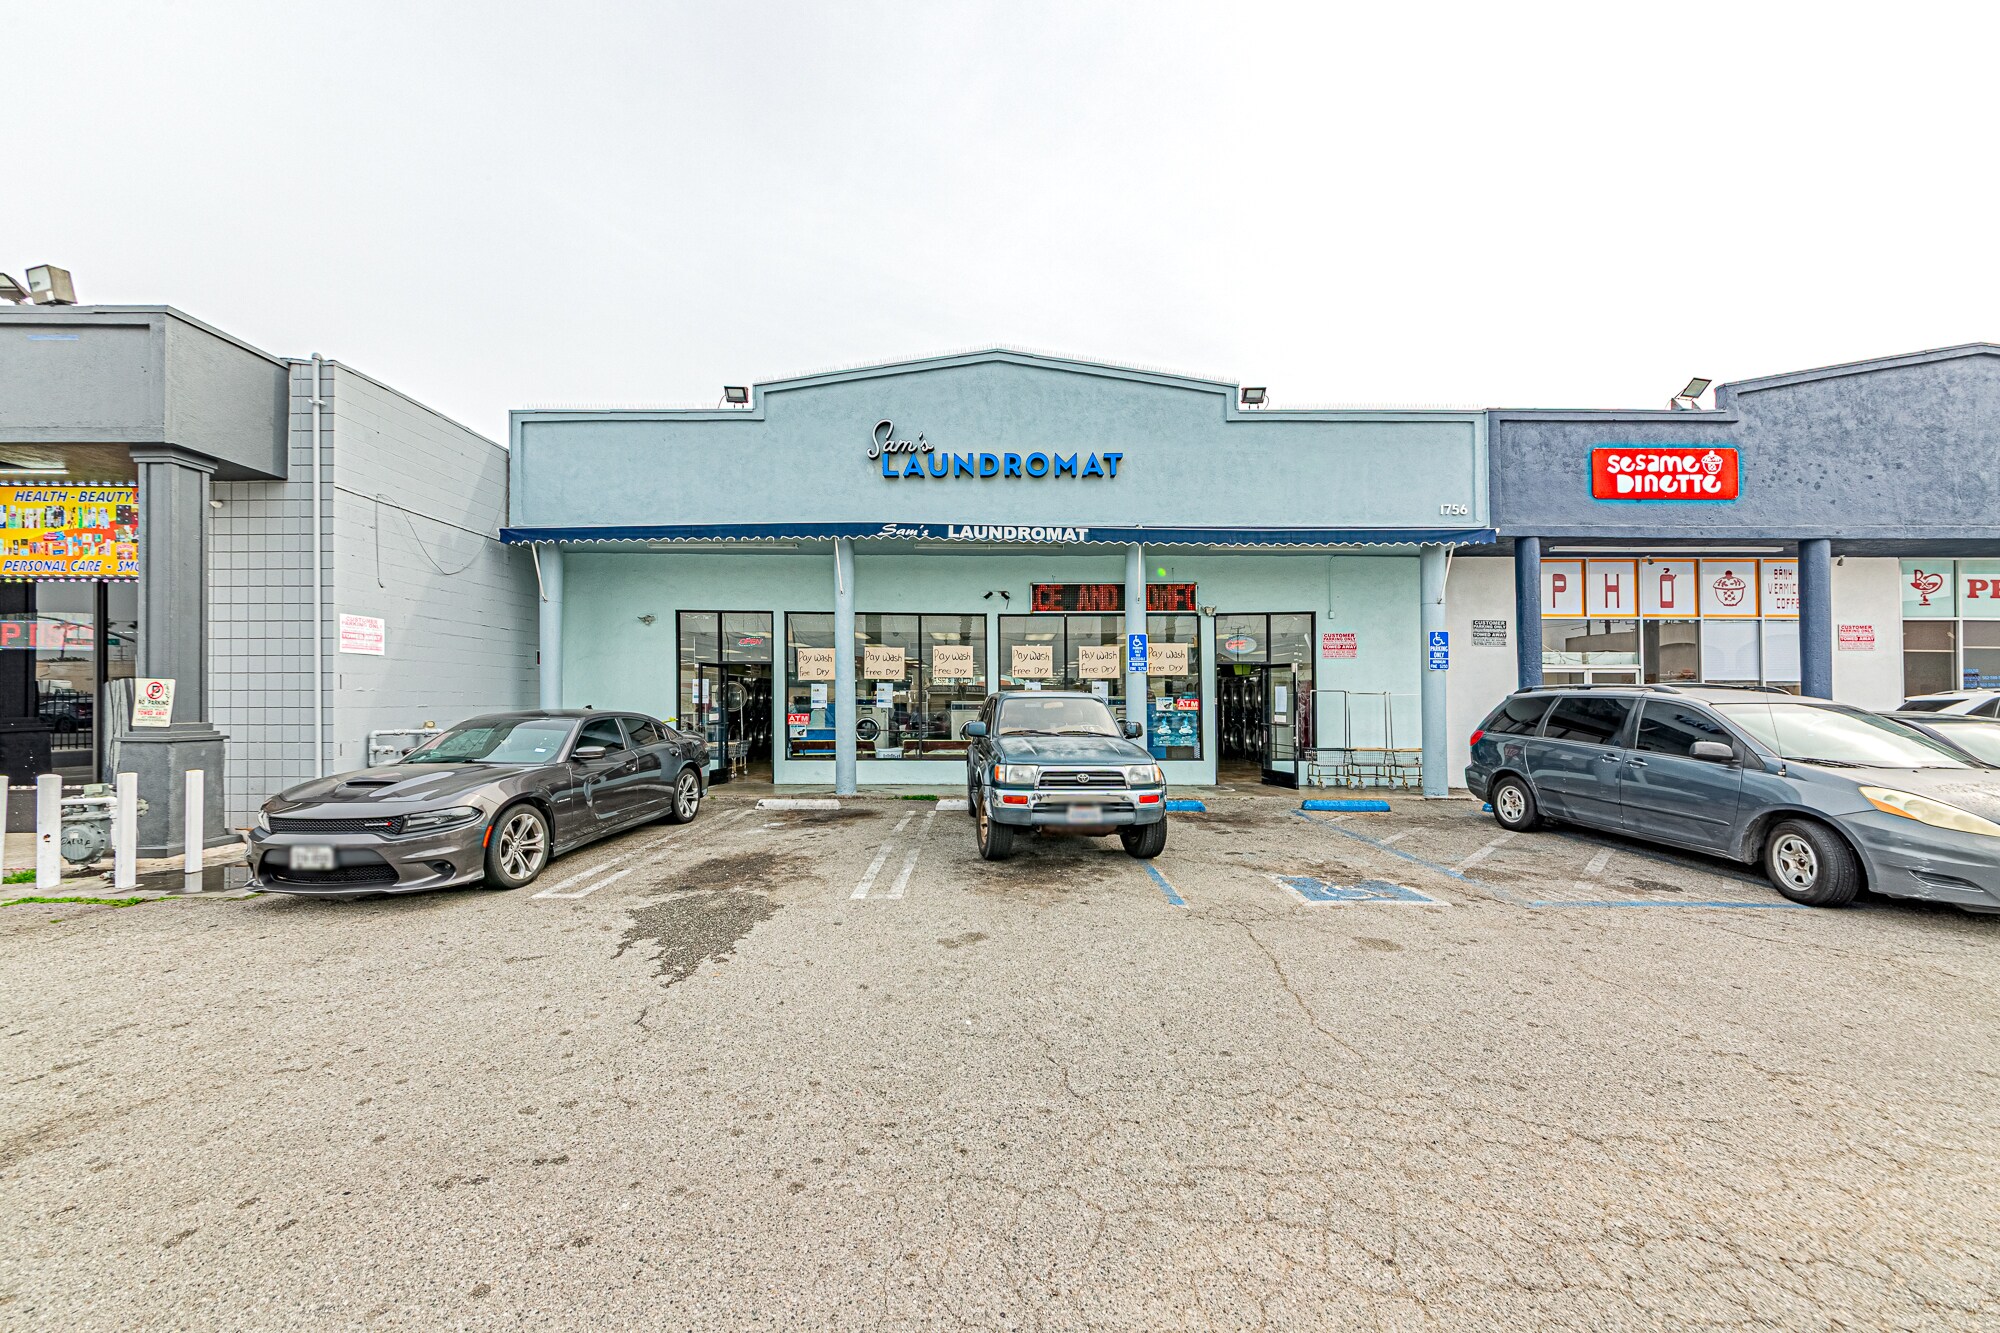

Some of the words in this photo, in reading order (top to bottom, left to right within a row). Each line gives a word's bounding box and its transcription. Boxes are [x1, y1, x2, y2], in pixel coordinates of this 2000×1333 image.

[867, 419, 935, 460] Sam's
[882, 452, 1123, 479] LAUNDROMAT
[14, 491, 69, 503] HEALTH
[78, 491, 133, 503] BEAUTY
[1440, 504, 1468, 515] 1756
[878, 524, 929, 537] Sam's
[948, 525, 1088, 541] LAUNDROMAT
[3, 560, 67, 572] PERSONAL
[71, 560, 102, 572] CARE
[1768, 583, 1799, 594] VERMIC
[1077, 584, 1118, 611] AND
[799, 651, 812, 664] Pay
[866, 651, 880, 663] Pay
[935, 649, 950, 664] Pay
[1013, 650, 1028, 662] Pay
[1082, 650, 1094, 662] Pay
[1148, 647, 1162, 660] Pay
[816, 668, 829, 676] Dry
[955, 668, 967, 676] Dry
[1034, 667, 1048, 676] Dry
[1101, 666, 1116, 675] Dry
[1169, 665, 1183, 673] Dry
